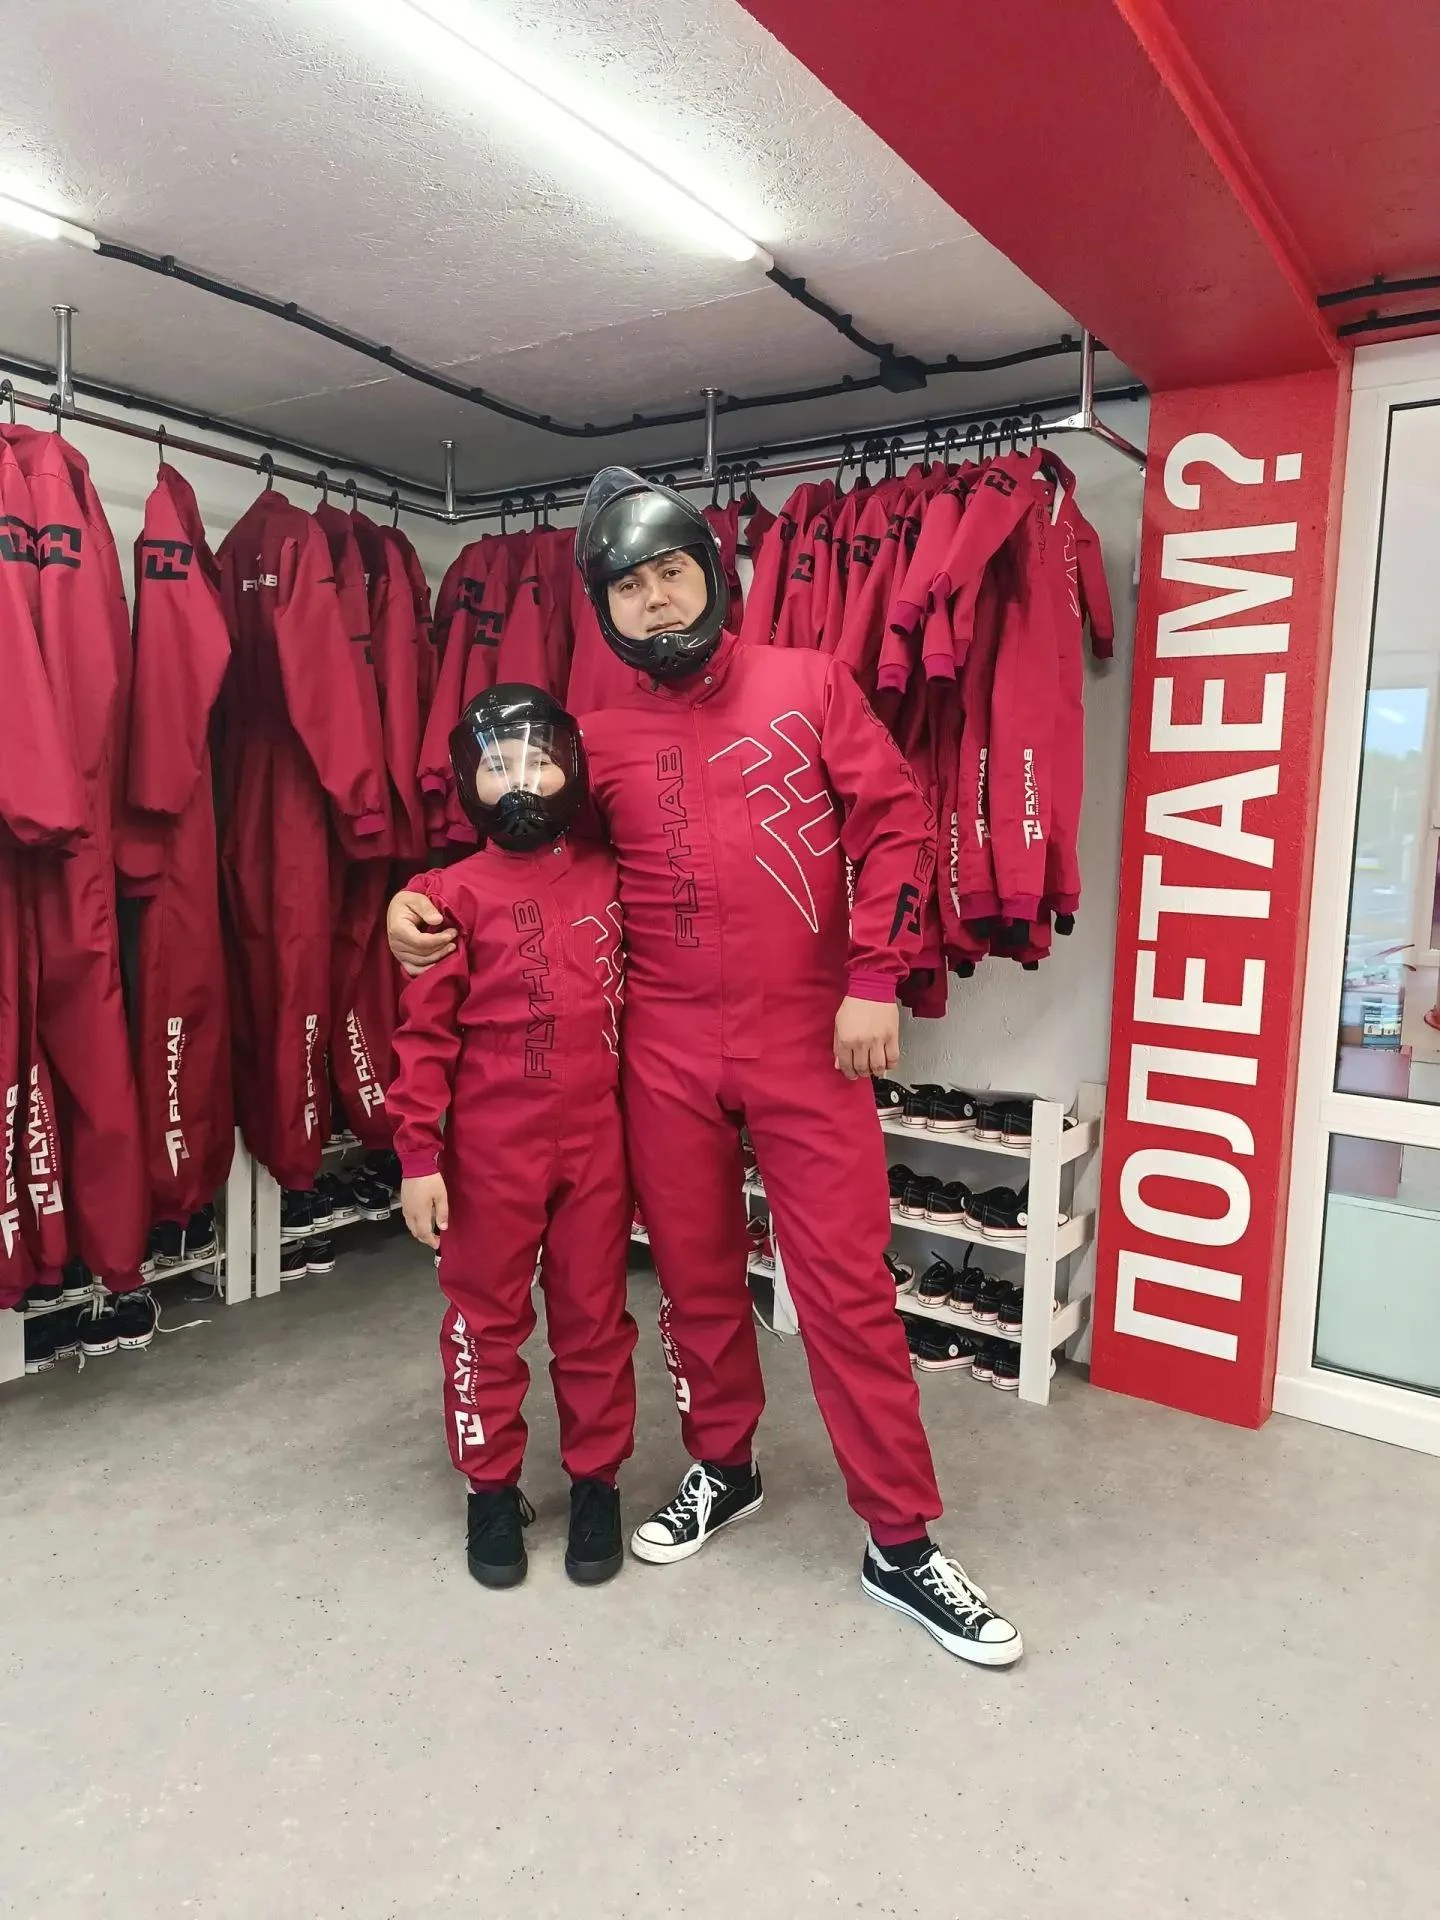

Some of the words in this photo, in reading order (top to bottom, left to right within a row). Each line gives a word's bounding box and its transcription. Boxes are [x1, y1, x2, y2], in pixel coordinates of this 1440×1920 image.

[656, 745, 701, 948] FLYHAB
[1025, 748, 1034, 816] FLYHAB
[1114, 432, 1302, 1361] ПОЛЕТАЕМ?
[513, 899, 556, 1079] FLYHAB
[28, 1064, 50, 1176] FLYHAB
[167, 1016, 182, 1123] FLYHAB
